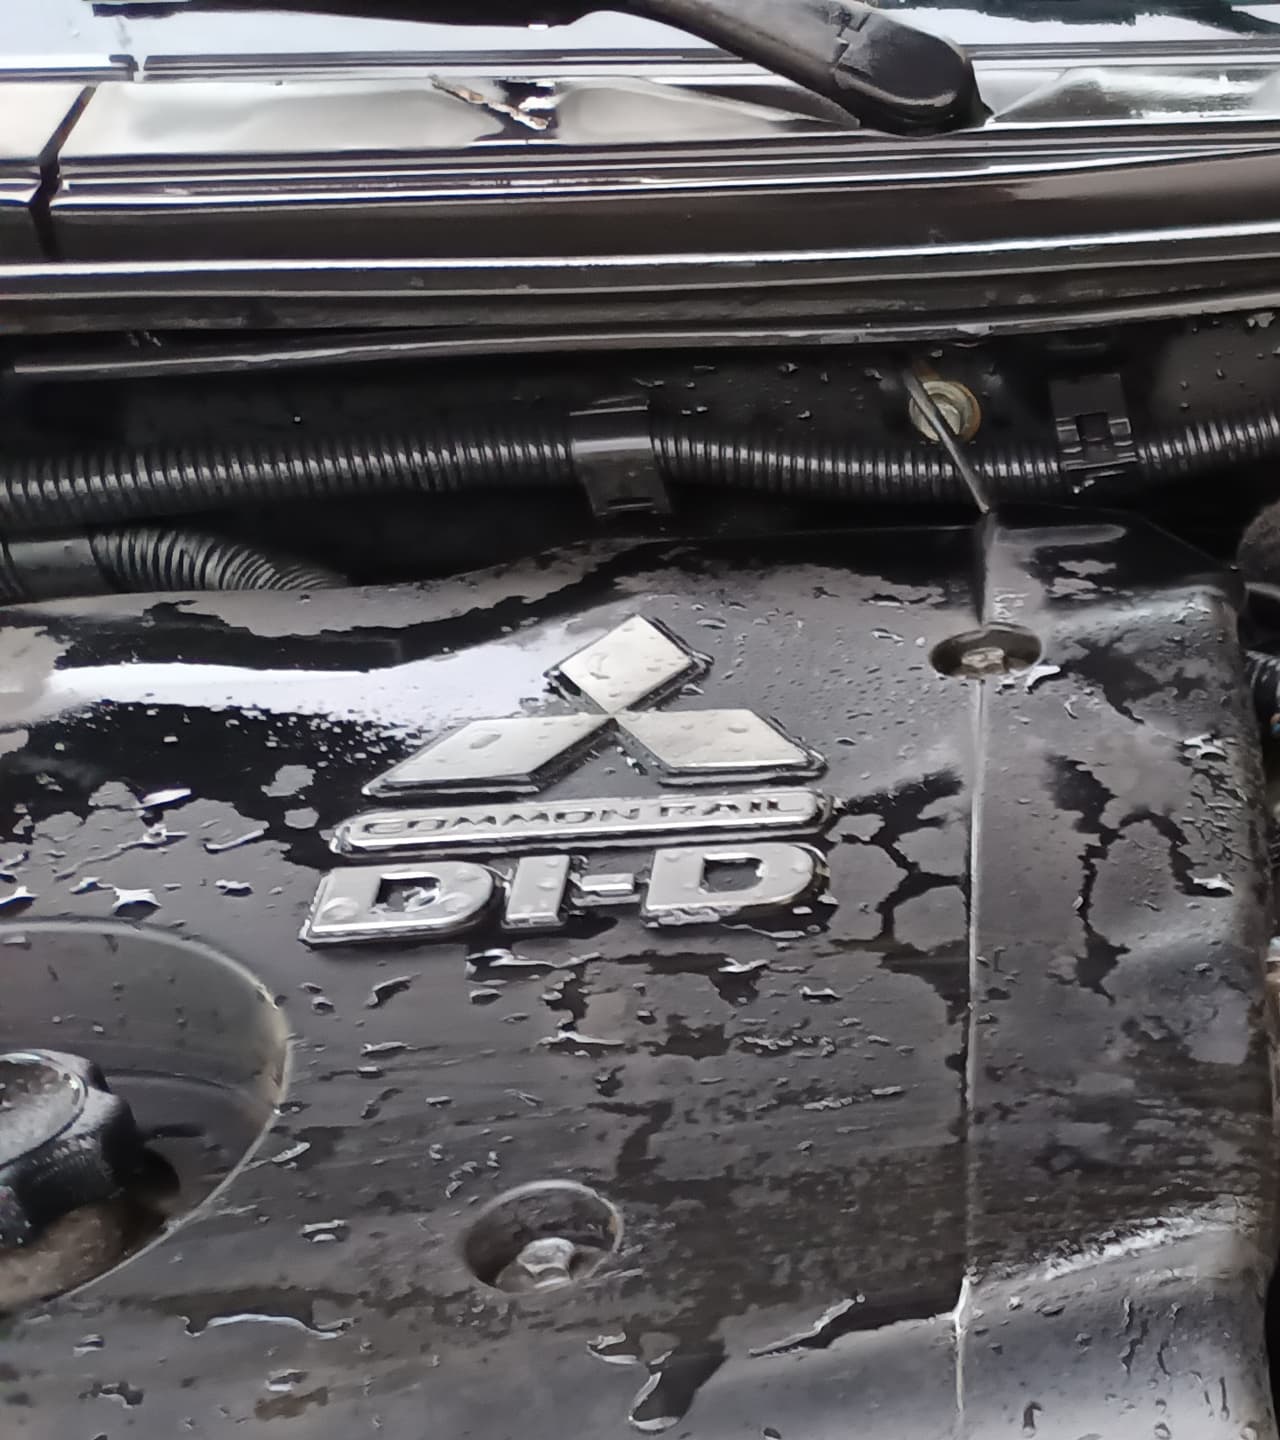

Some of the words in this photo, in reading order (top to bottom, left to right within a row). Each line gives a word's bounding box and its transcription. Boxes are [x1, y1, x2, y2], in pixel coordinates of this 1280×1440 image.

[362, 806, 641, 835] COMMON
[657, 794, 811, 819] RAIL
[301, 844, 829, 944] DI-D
